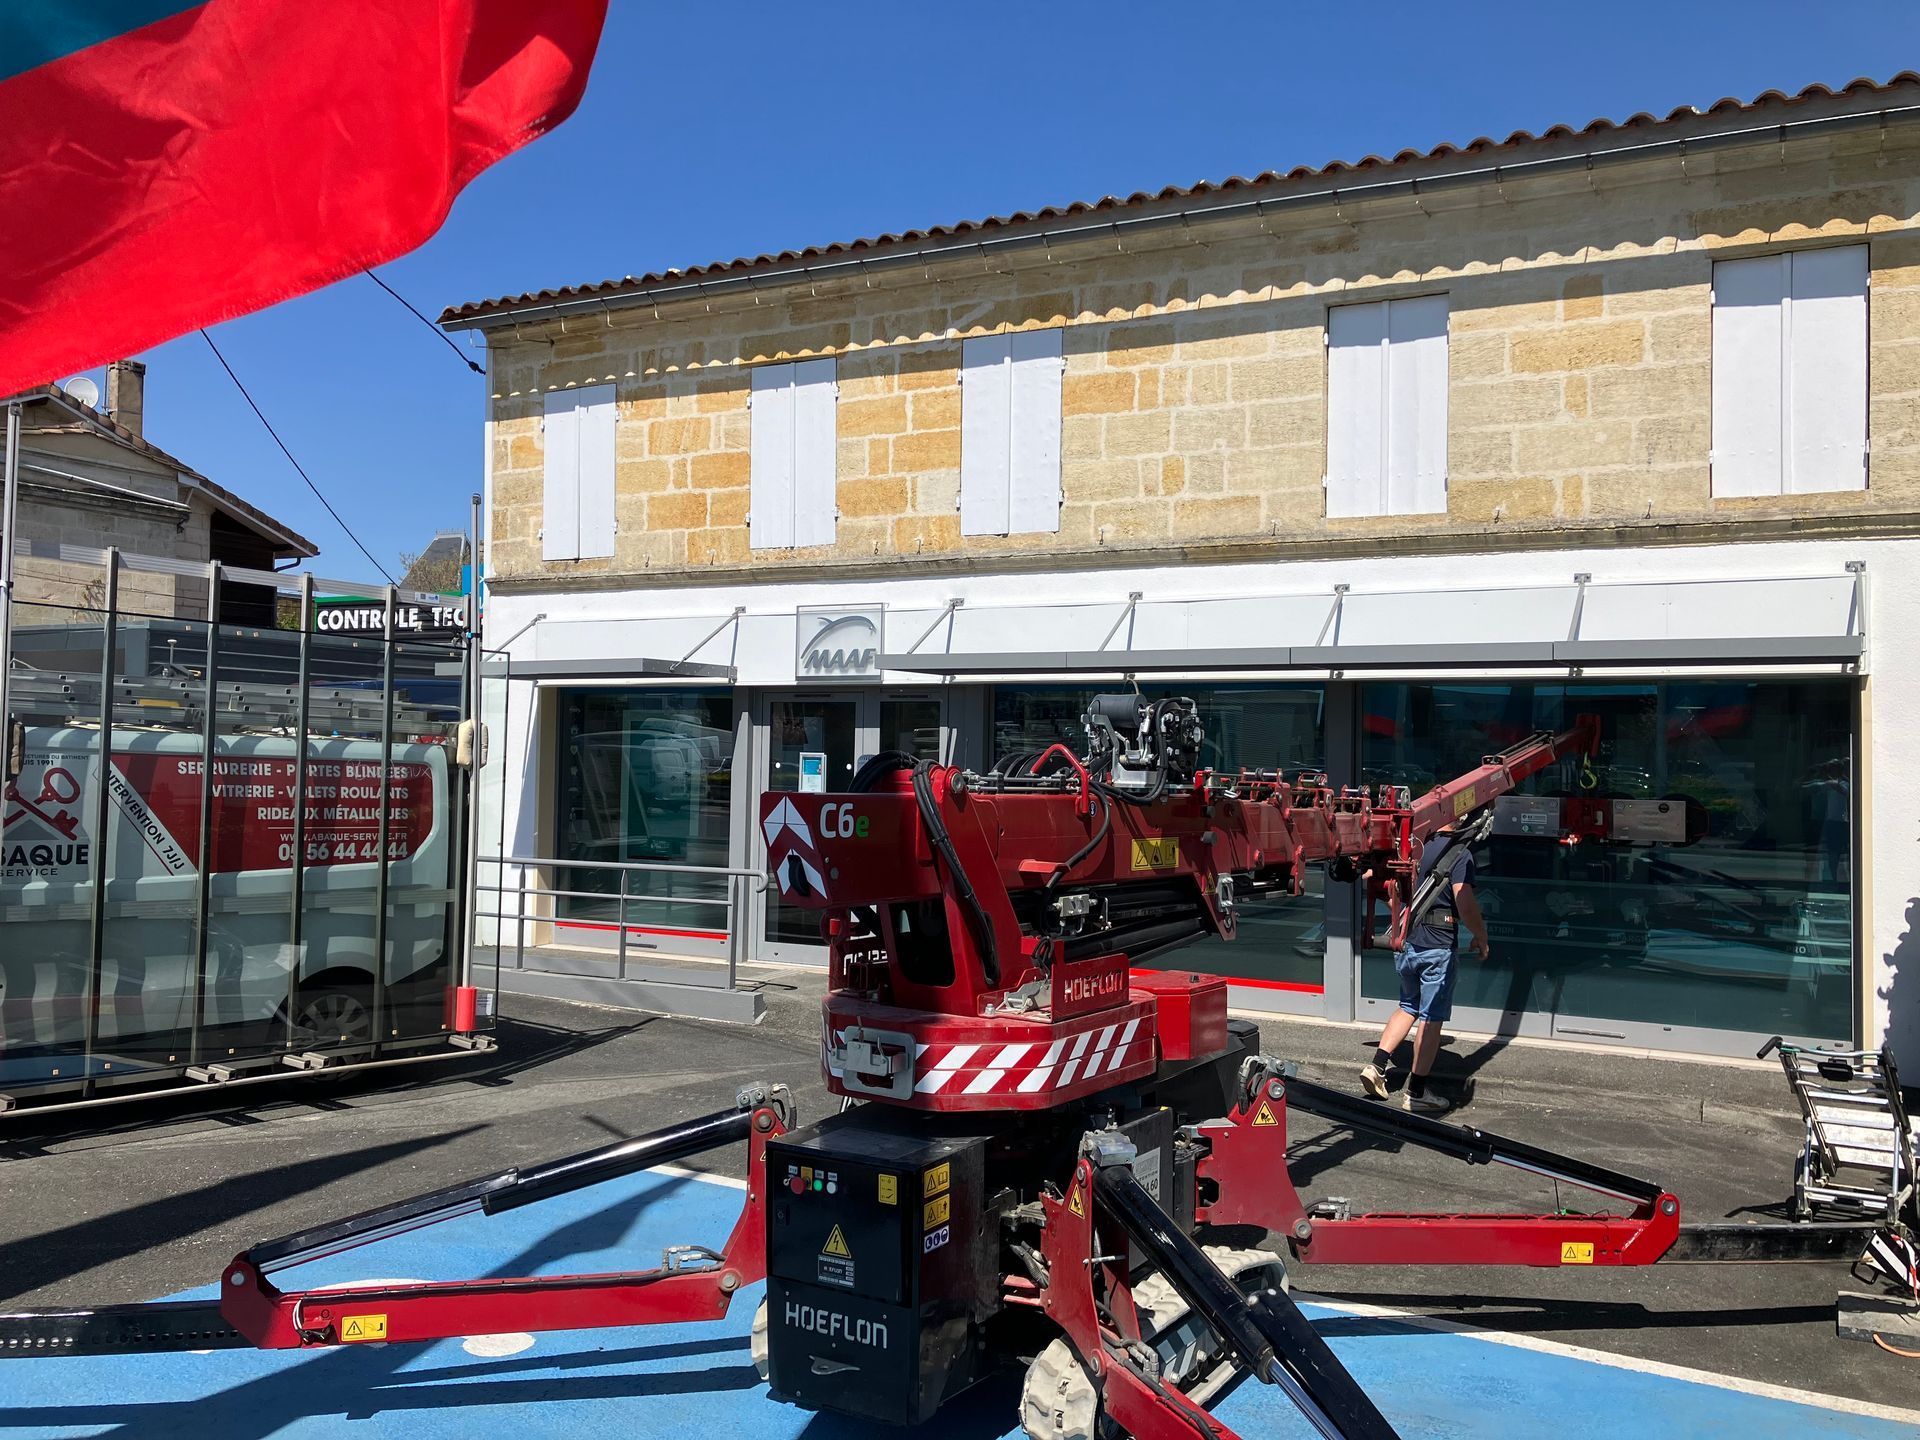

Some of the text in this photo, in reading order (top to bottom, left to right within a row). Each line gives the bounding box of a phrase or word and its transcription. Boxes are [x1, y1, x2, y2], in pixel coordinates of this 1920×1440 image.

[803, 648, 876, 668] MAAF
[286, 764, 341, 778] PRTES
[346, 765, 408, 779] BLINES
[212, 784, 275, 798] VITRERIE
[286, 785, 337, 799] VLETS
[108, 770, 166, 845] NTERVENTION
[820, 802, 869, 838] C6e
[280, 831, 408, 841] WW.ABAQUE-SERVE.FR
[1, 844, 89, 866] AQUE
[306, 842, 329, 860] 56
[333, 842, 357, 860] 44
[361, 841, 380, 859] 44
[387, 841, 408, 859] 44
[1064, 970, 1124, 1003] HOEFLON
[785, 1301, 888, 1350] HOEFLON
